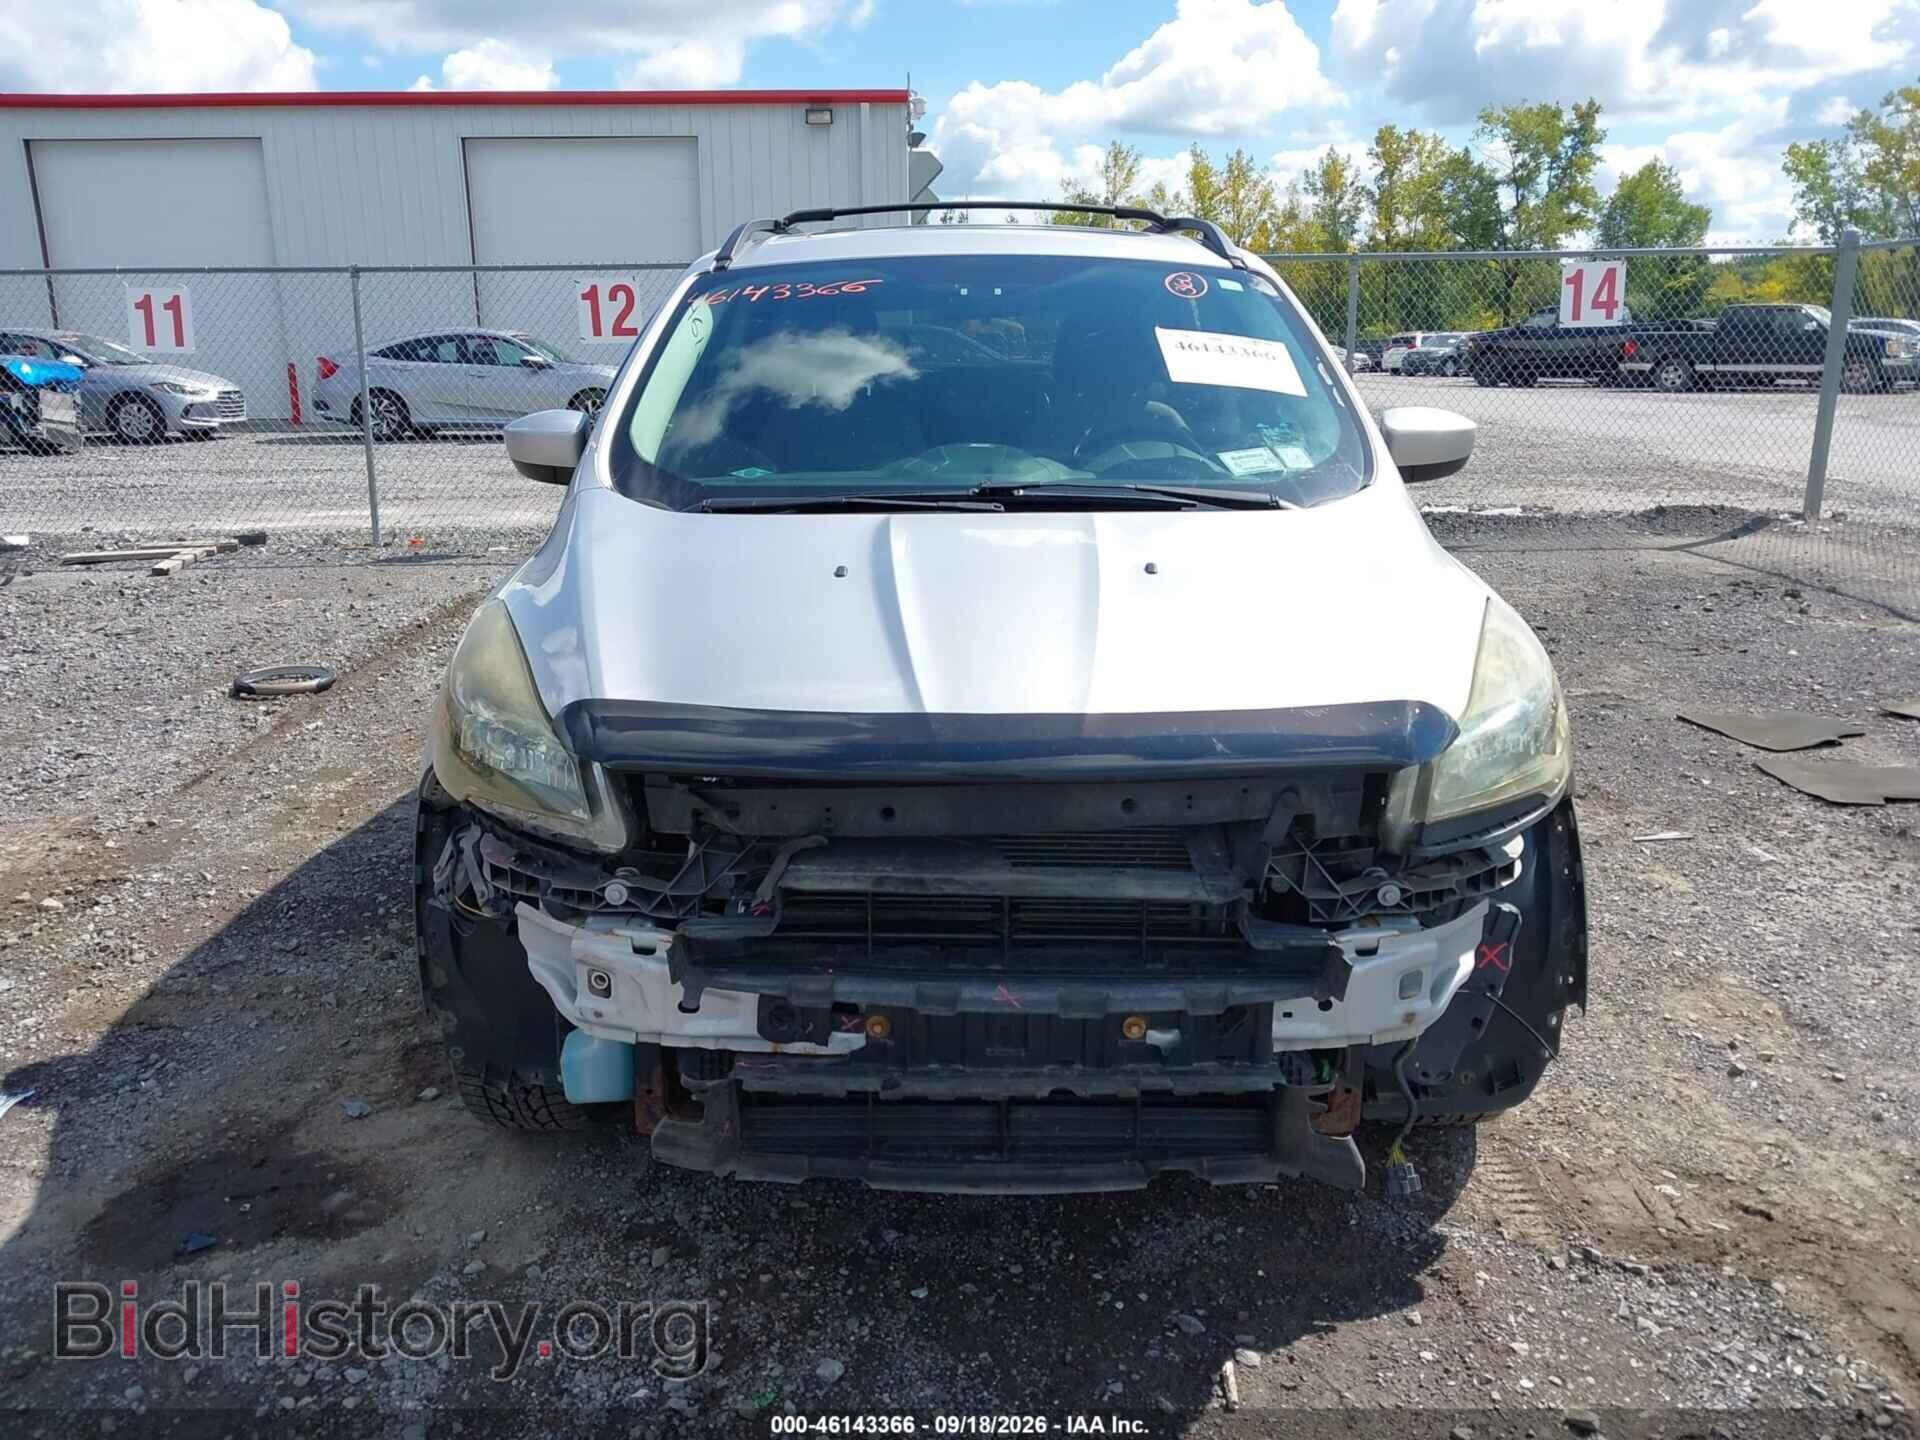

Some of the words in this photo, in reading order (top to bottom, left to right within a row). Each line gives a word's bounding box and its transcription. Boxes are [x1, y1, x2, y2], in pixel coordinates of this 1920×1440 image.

[134, 294, 185, 348] 11
[580, 283, 639, 337] 12
[1565, 267, 1619, 321] 14
